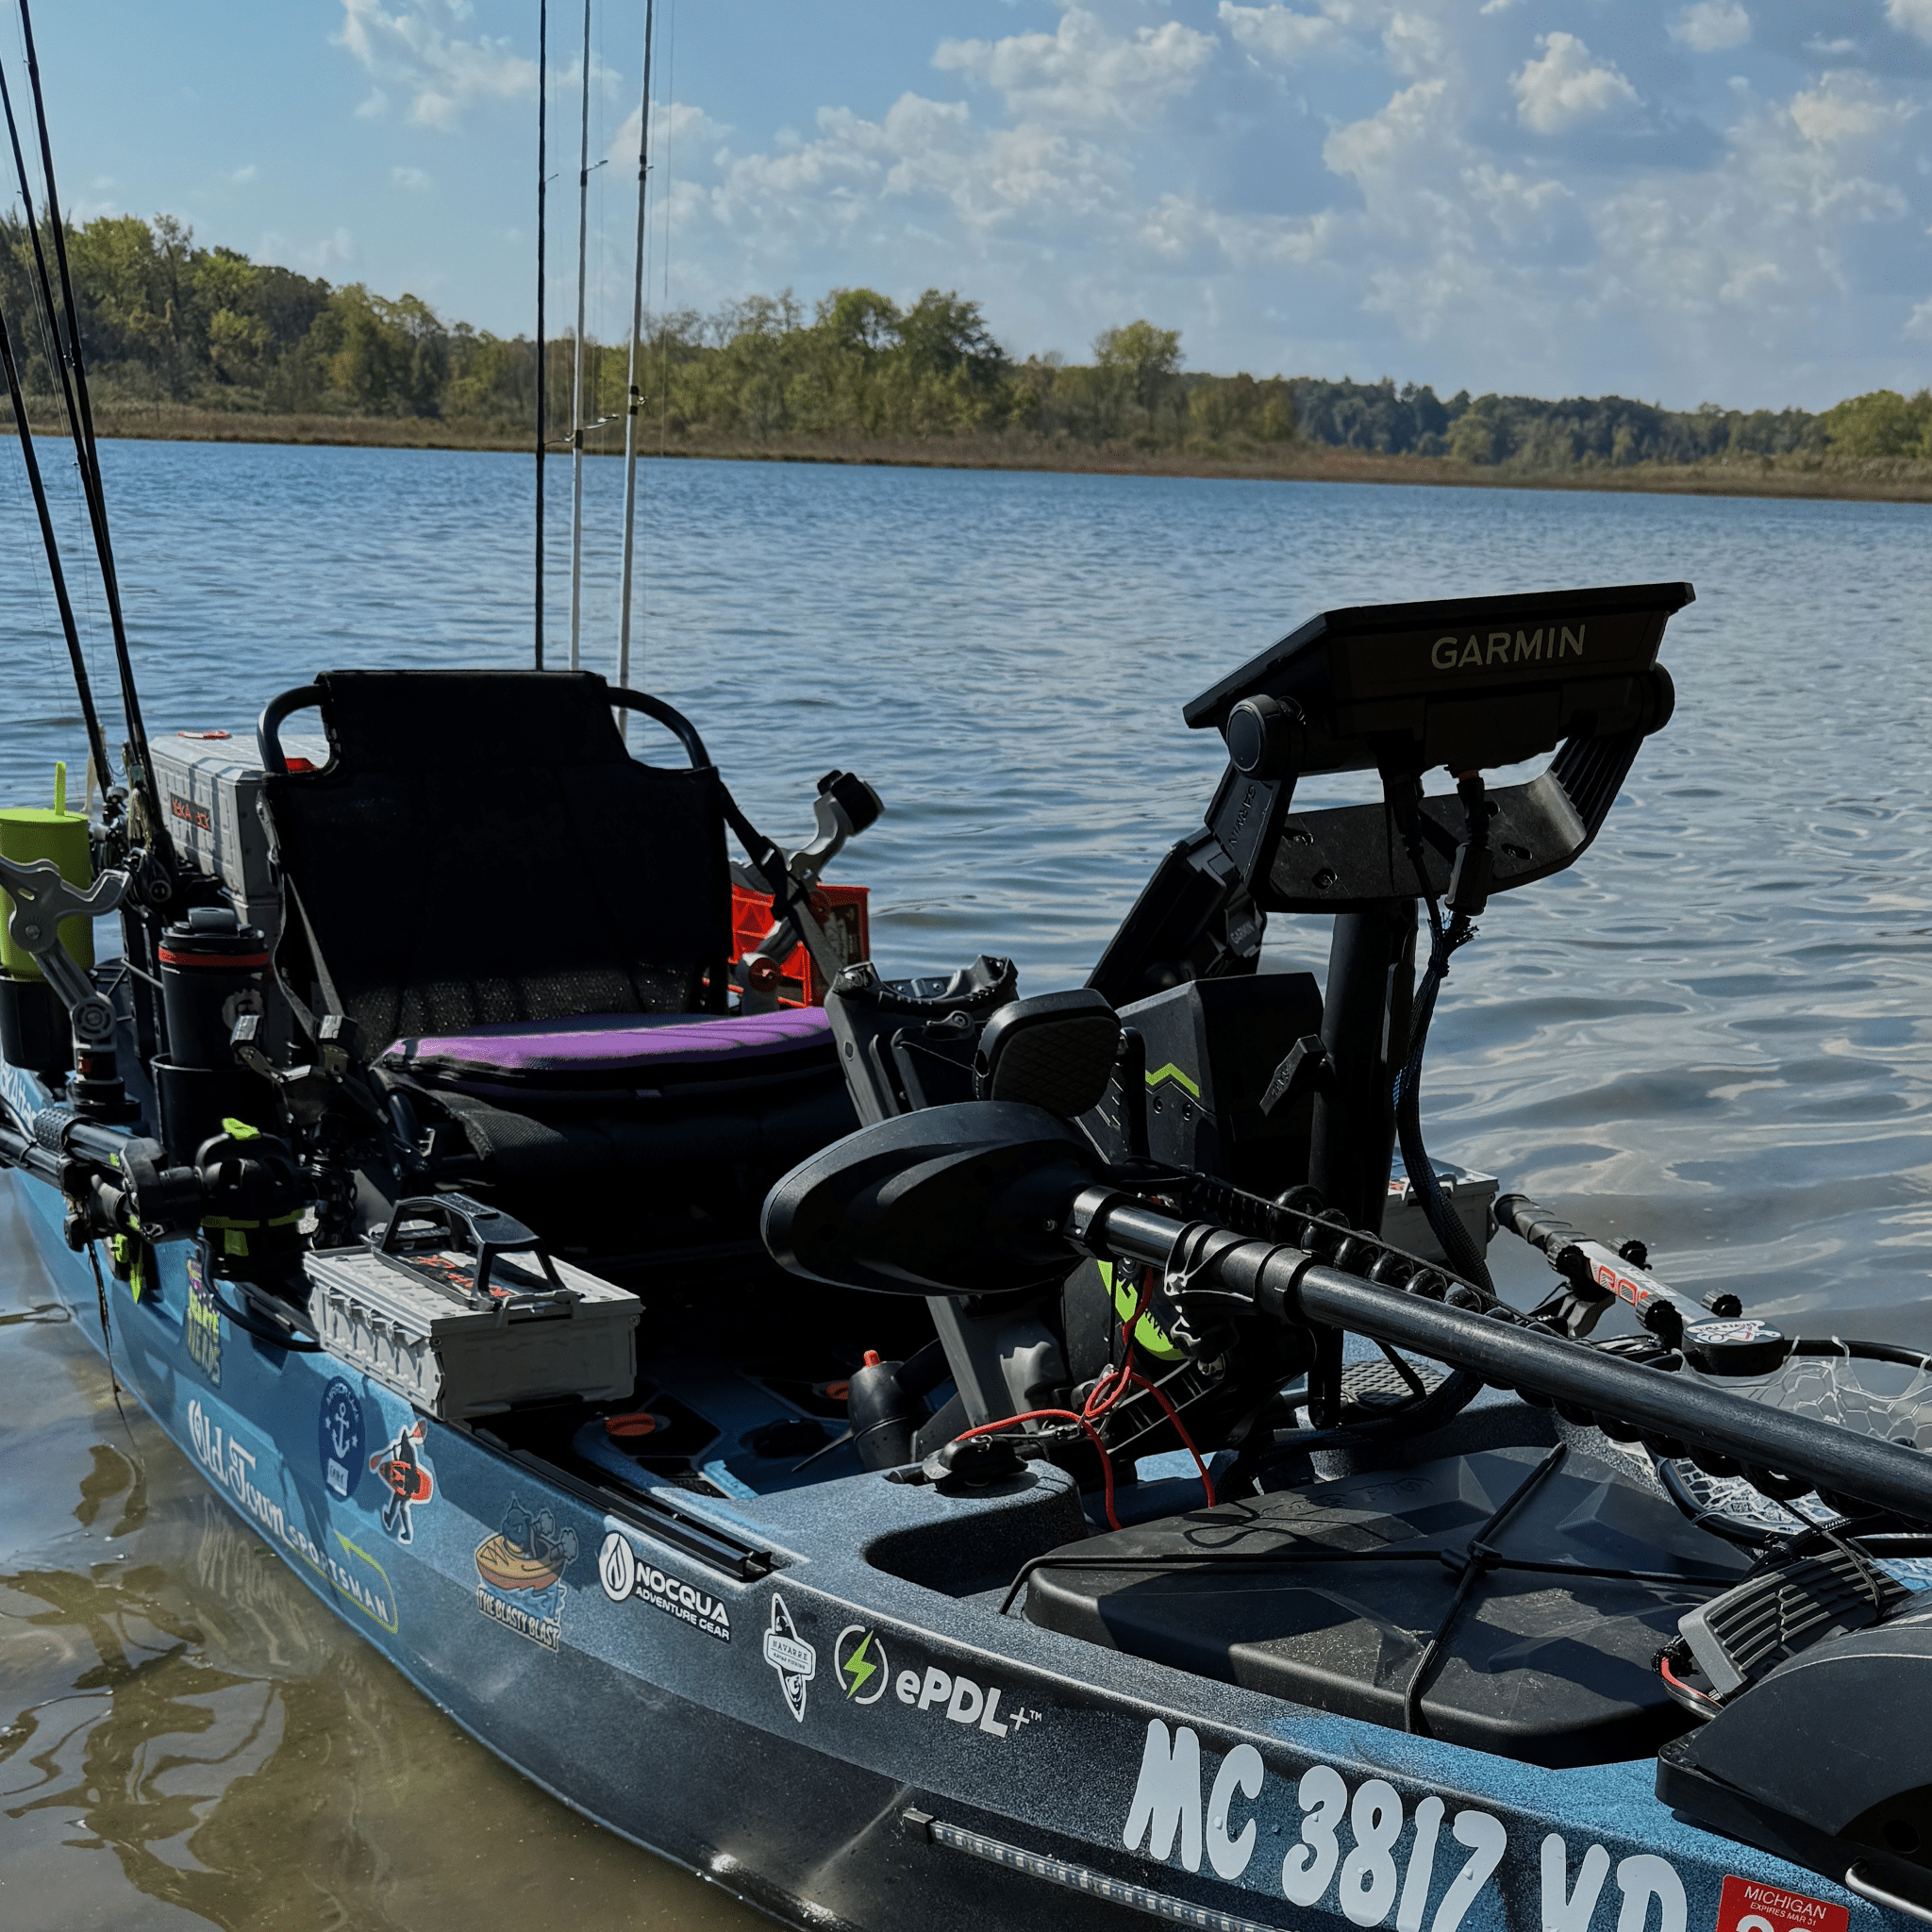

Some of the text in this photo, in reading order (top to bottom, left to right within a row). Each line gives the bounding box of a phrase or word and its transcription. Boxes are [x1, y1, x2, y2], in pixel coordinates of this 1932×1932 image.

[1431, 625, 1586, 670] GARMIN
[189, 1399, 229, 1488] Old
[289, 1525, 390, 1624] SPORTSMAN
[478, 1590, 559, 1649] THE BLASTY BLAST
[635, 1586, 730, 1641] ADVENTURE GEAR
[636, 1562, 730, 1627] NOCQUA
[773, 1641, 808, 1661] NAVARRE
[1123, 1718, 1265, 1880] MC
[1282, 1765, 1507, 1932] 3817
[1744, 1886, 1827, 1920] MICHIGAN
[1750, 1901, 1786, 1919] EXPIRES
[1787, 1911, 1807, 1924] MAR
[1807, 1918, 1818, 1926] 31
